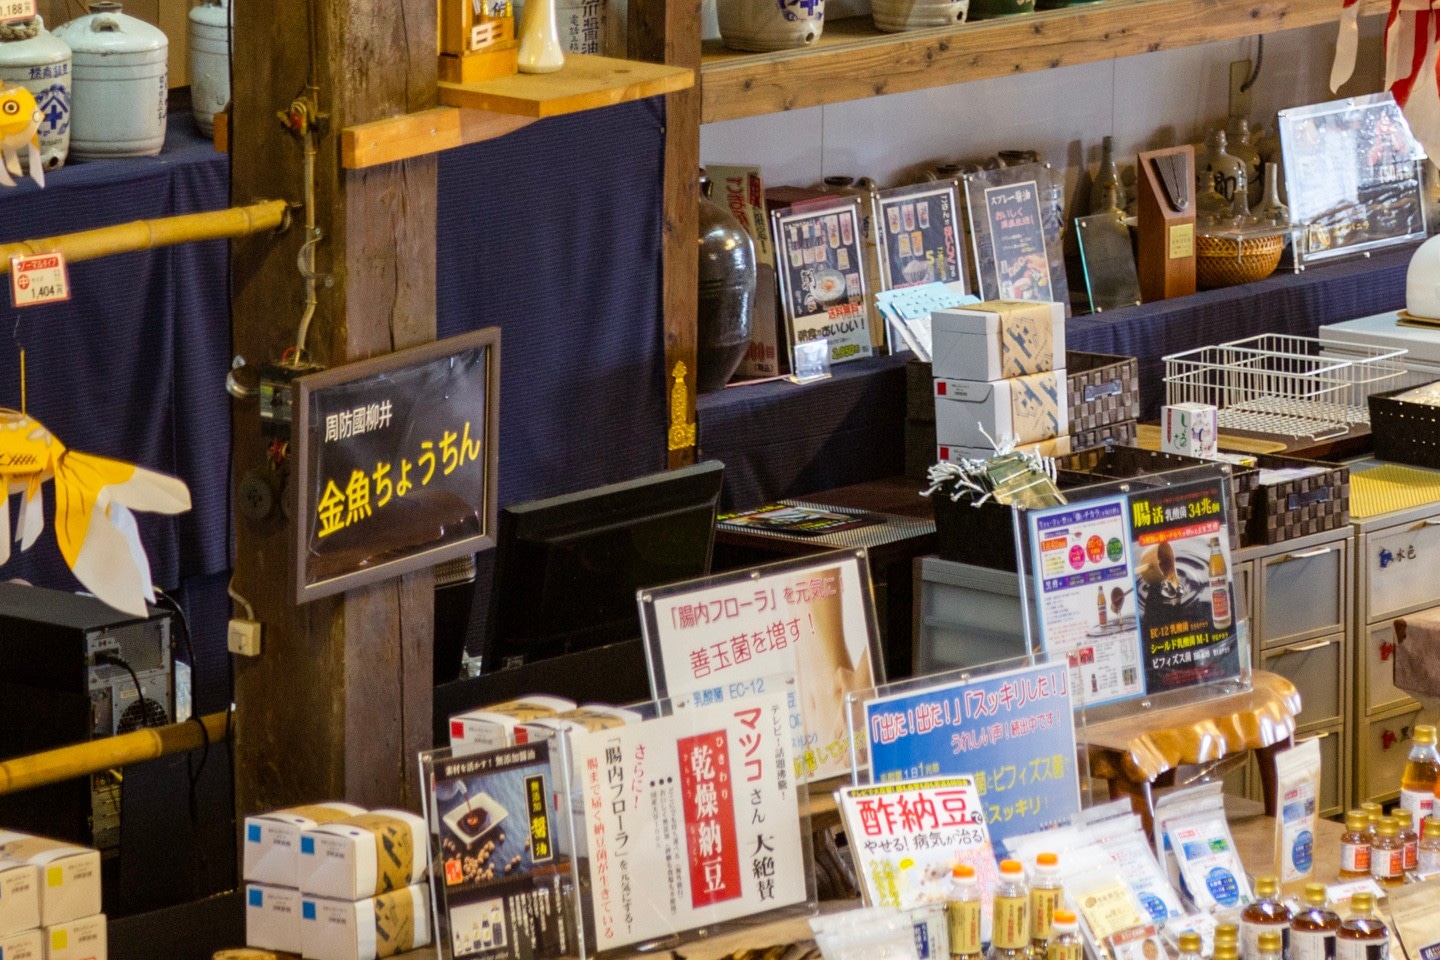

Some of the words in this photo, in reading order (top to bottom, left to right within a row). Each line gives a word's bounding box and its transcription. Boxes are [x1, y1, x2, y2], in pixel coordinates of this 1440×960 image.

[325, 400, 393, 442] 周防國柳井
[318, 421, 481, 538] 金魚ちょうちん
[690, 744, 727, 895] 乾燥納豆
[856, 790, 976, 837] 酢納豆
